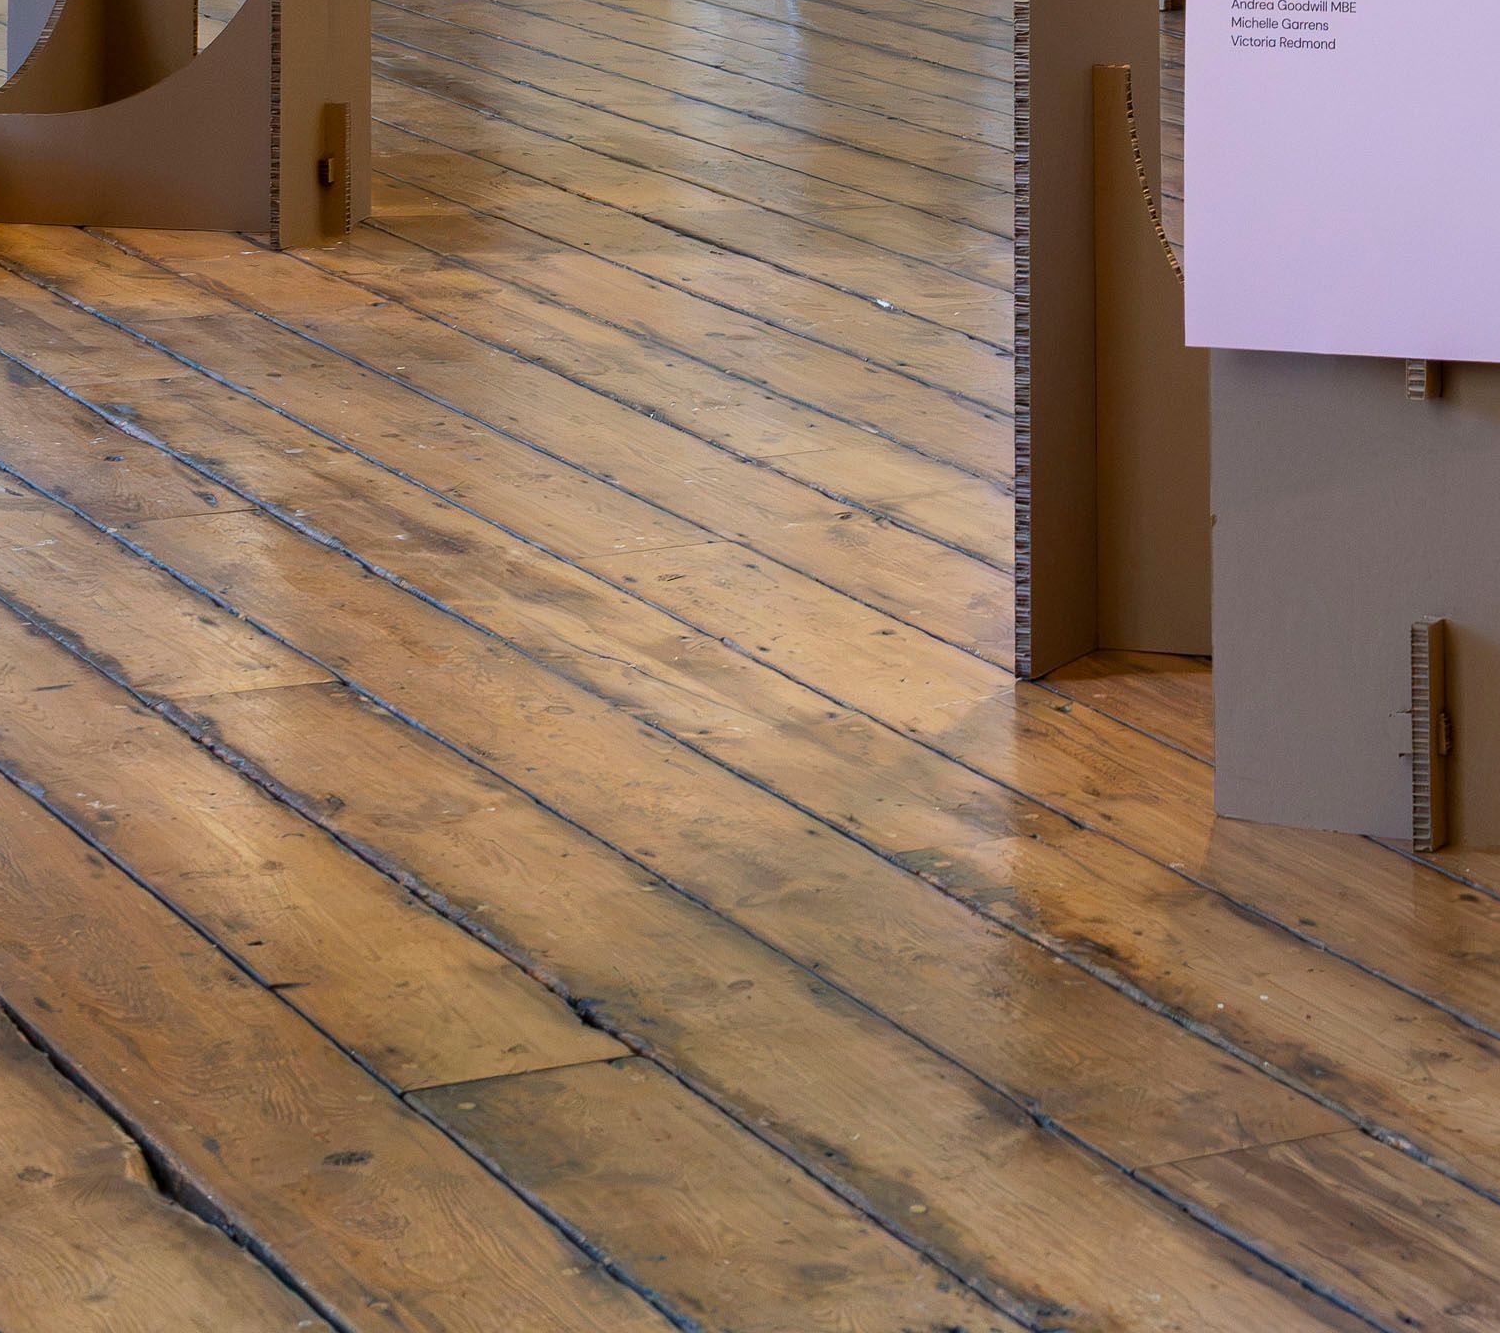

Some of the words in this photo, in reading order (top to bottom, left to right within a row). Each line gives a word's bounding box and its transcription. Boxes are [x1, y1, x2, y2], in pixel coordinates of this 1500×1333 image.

[1277, 0, 1328, 12] Goodwill
[1330, 1, 1357, 13] MBE
[1231, 16, 1279, 29] Michelle
[1281, 18, 1329, 31] Garrens
[1230, 35, 1276, 48] Victoria
[1279, 36, 1336, 50] Redmond
